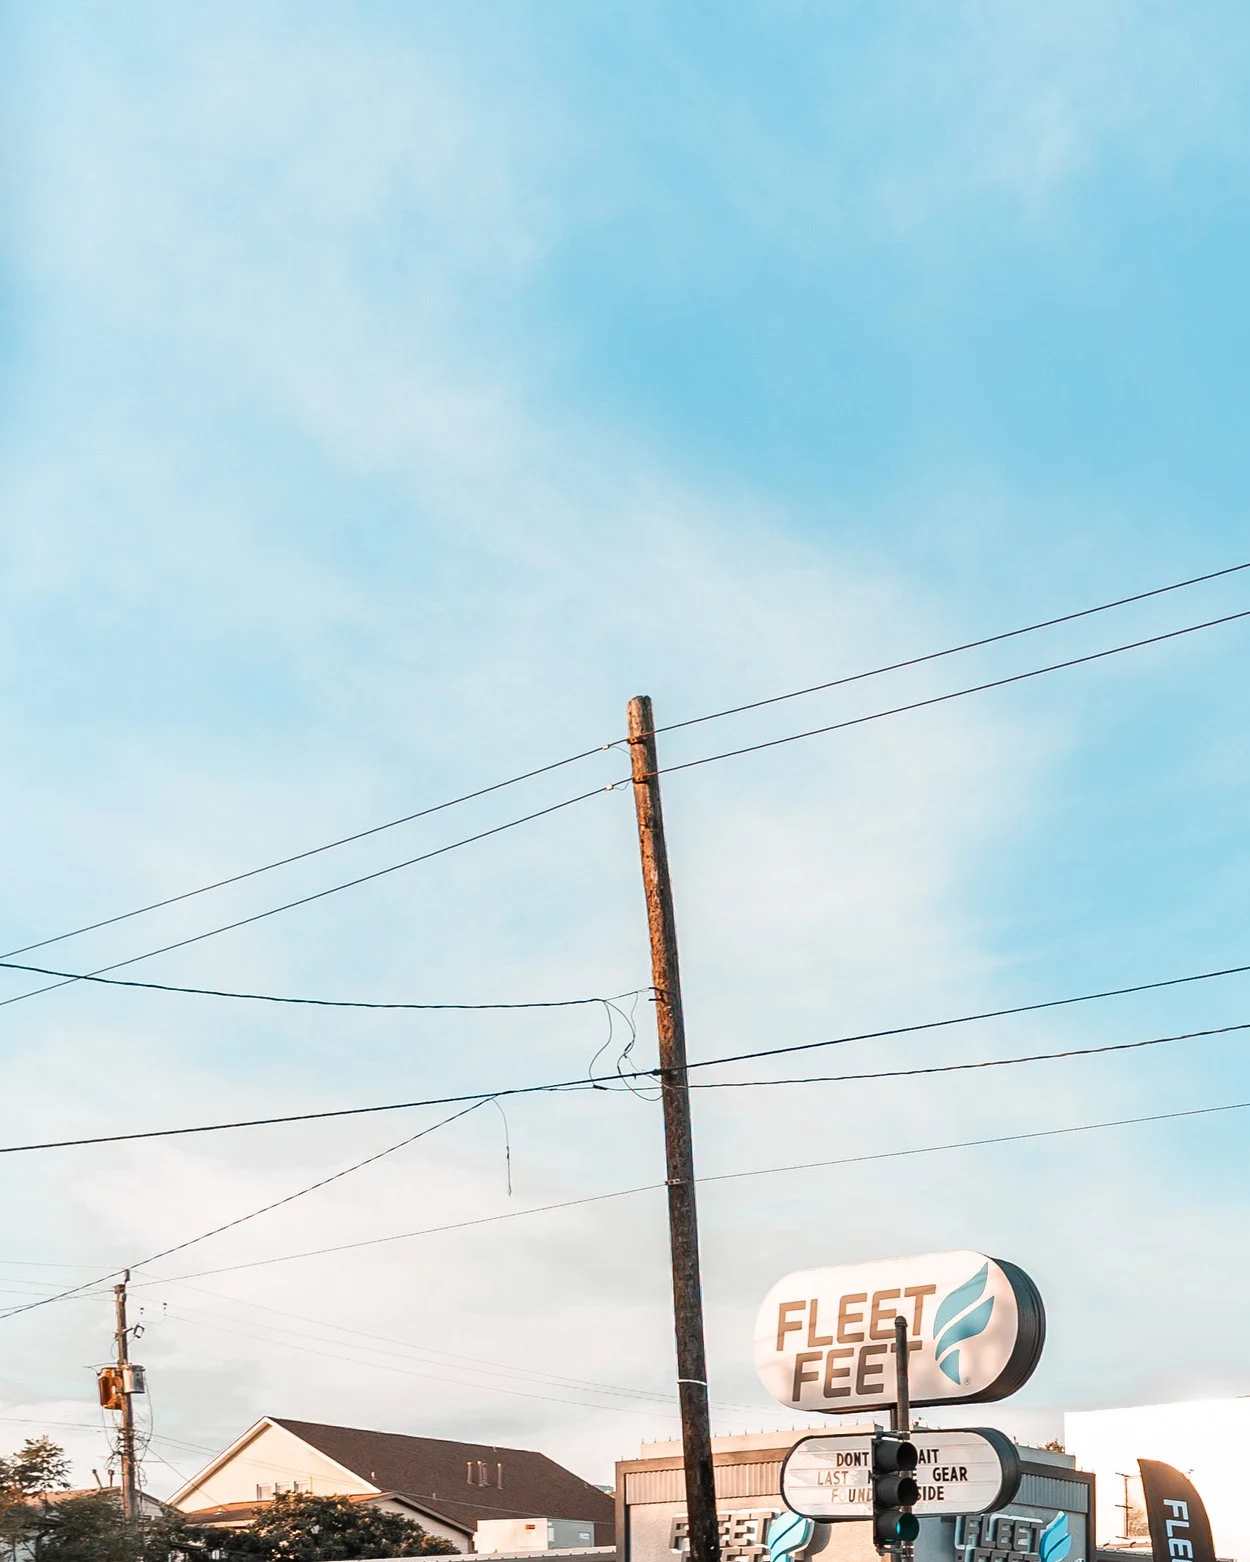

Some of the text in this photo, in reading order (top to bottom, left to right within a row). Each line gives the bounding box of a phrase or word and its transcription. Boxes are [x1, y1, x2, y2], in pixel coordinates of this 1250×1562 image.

[776, 1284, 936, 1351] FLEET
[836, 1449, 939, 1467] DONT AIT
[817, 1471, 849, 1485] LAST
[933, 1467, 968, 1482] GEAR
[963, 1514, 1046, 1553] FLEET
